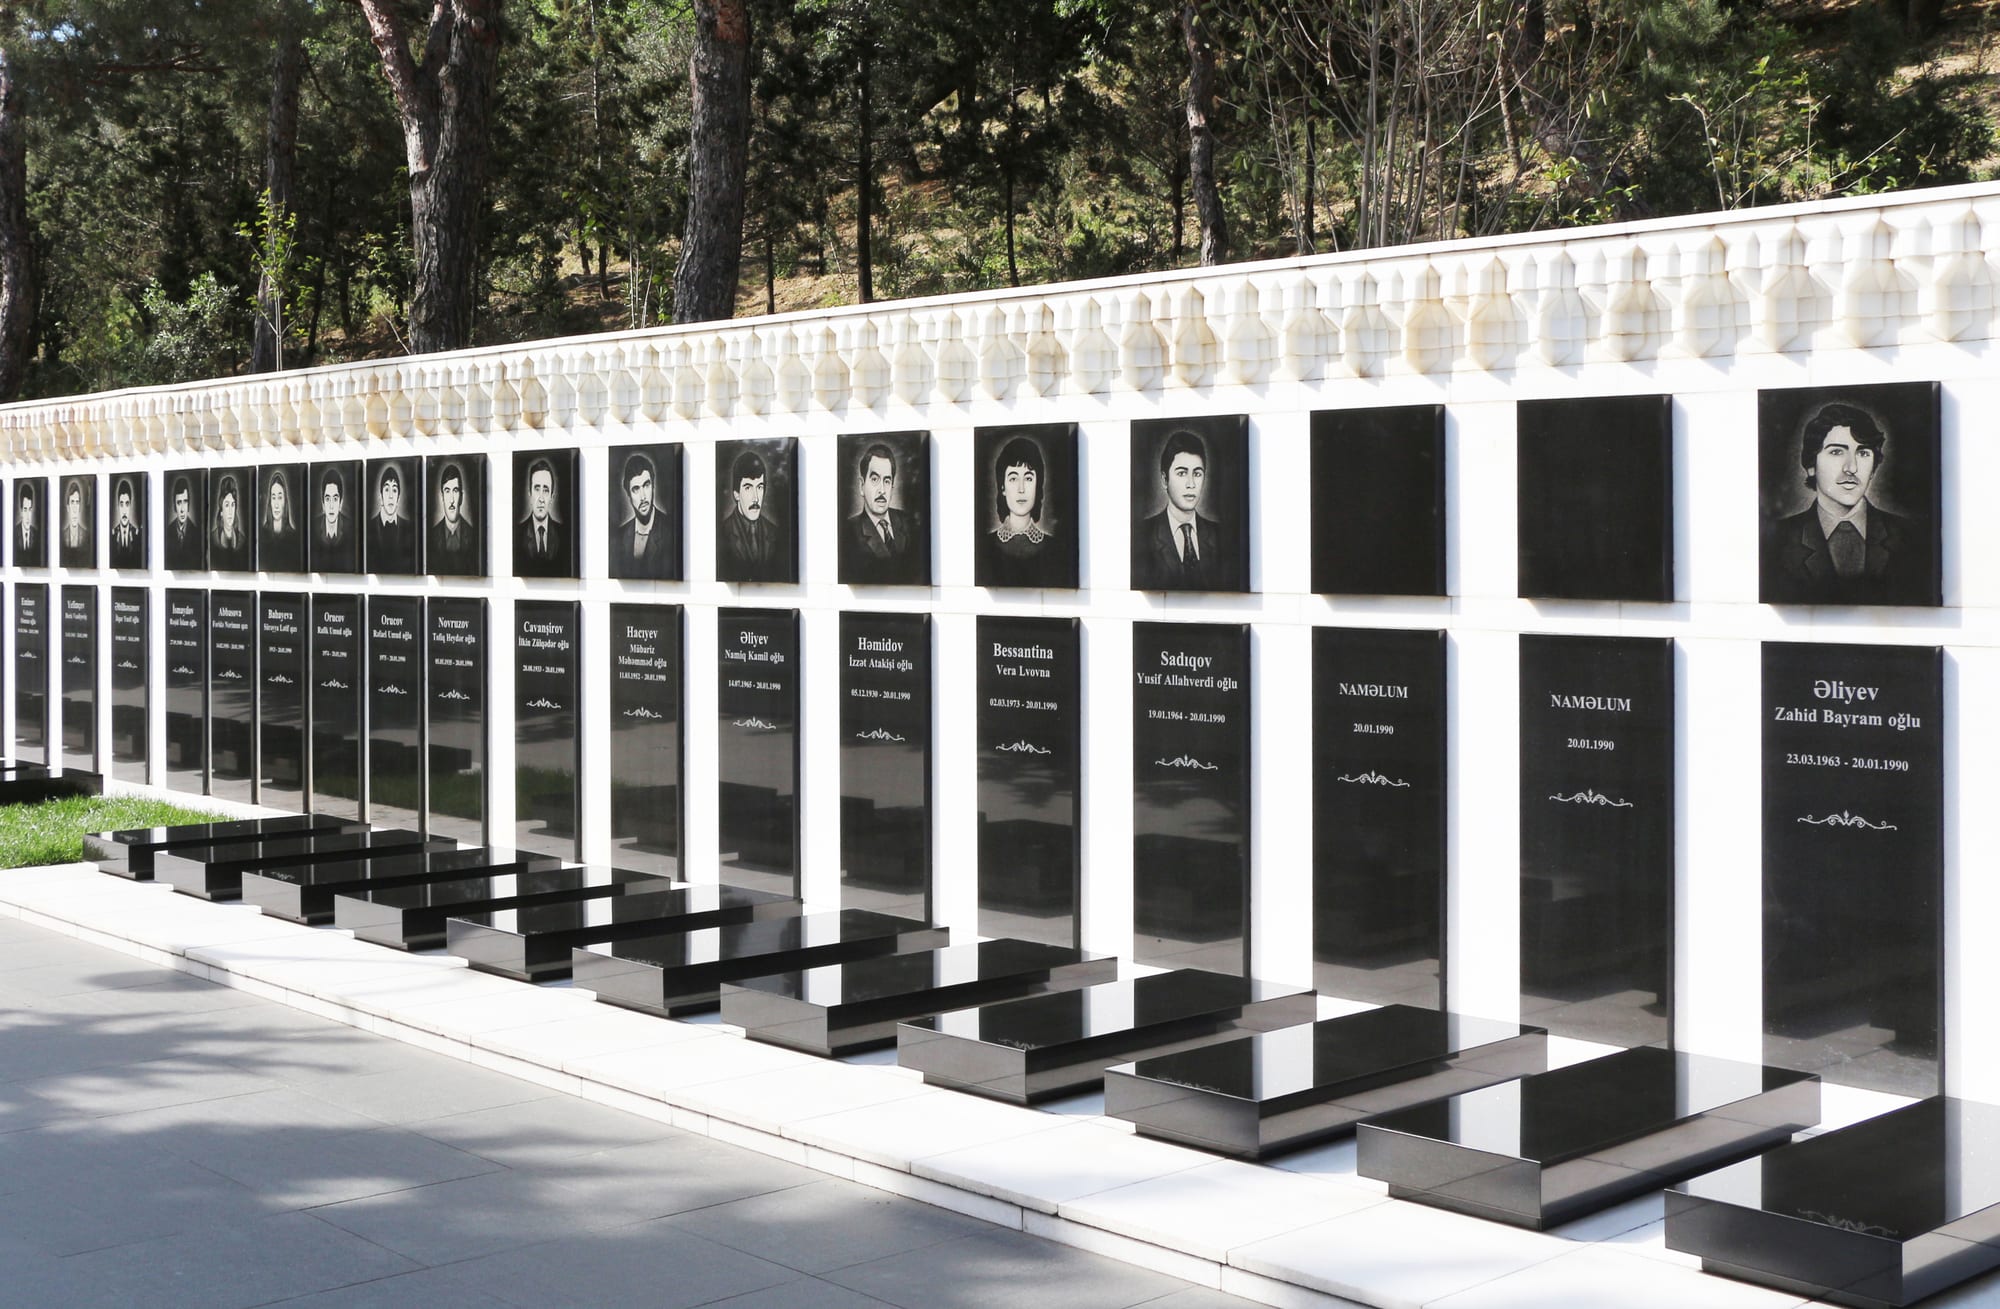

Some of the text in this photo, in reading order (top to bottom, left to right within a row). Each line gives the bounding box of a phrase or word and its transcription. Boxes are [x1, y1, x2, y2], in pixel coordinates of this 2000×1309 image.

[324, 612, 345, 622] Orucov
[381, 614, 404, 626] Orucov
[438, 617, 470, 629] Novruzov
[524, 620, 564, 636] Cavanşirov
[626, 626, 658, 641] Hacıyev
[465, 634, 476, 645] oğlu
[557, 638, 570, 650] oğlu
[740, 631, 768, 646] Əliyev
[858, 637, 904, 652] Həmidov
[630, 644, 655, 654] Mübariz
[724, 648, 785, 663] Namiq Kamil oğlu
[993, 642, 1054, 660] Bessantina
[618, 655, 667, 669] Məhəmməd oğlu
[849, 656, 913, 672] İzzət Atakişi oğlu
[1160, 650, 1212, 670] Sadıqov
[996, 664, 1050, 678] Vera Lvovna
[1137, 672, 1238, 691] Yusif Allahverdi oğlu
[882, 690, 911, 701] 20.01.1990
[1339, 682, 1408, 699] NAMƏLUM
[1813, 678, 1880, 705] Əliyev
[989, 698, 1020, 709] 02.03.1973
[1026, 700, 1058, 711] 20.01.1990
[1550, 694, 1632, 712] NAMƏLUM
[1148, 709, 1183, 720] 19.01.1964
[1189, 712, 1226, 724] 20.01.1990
[1774, 706, 1921, 732] Zahid Bayram oğlu
[1353, 723, 1394, 735] 20.01.1990
[1567, 737, 1614, 751] 20.01.1990
[1786, 753, 1841, 768] 23.03.1963
[1851, 756, 1909, 772] 20.01.1990
